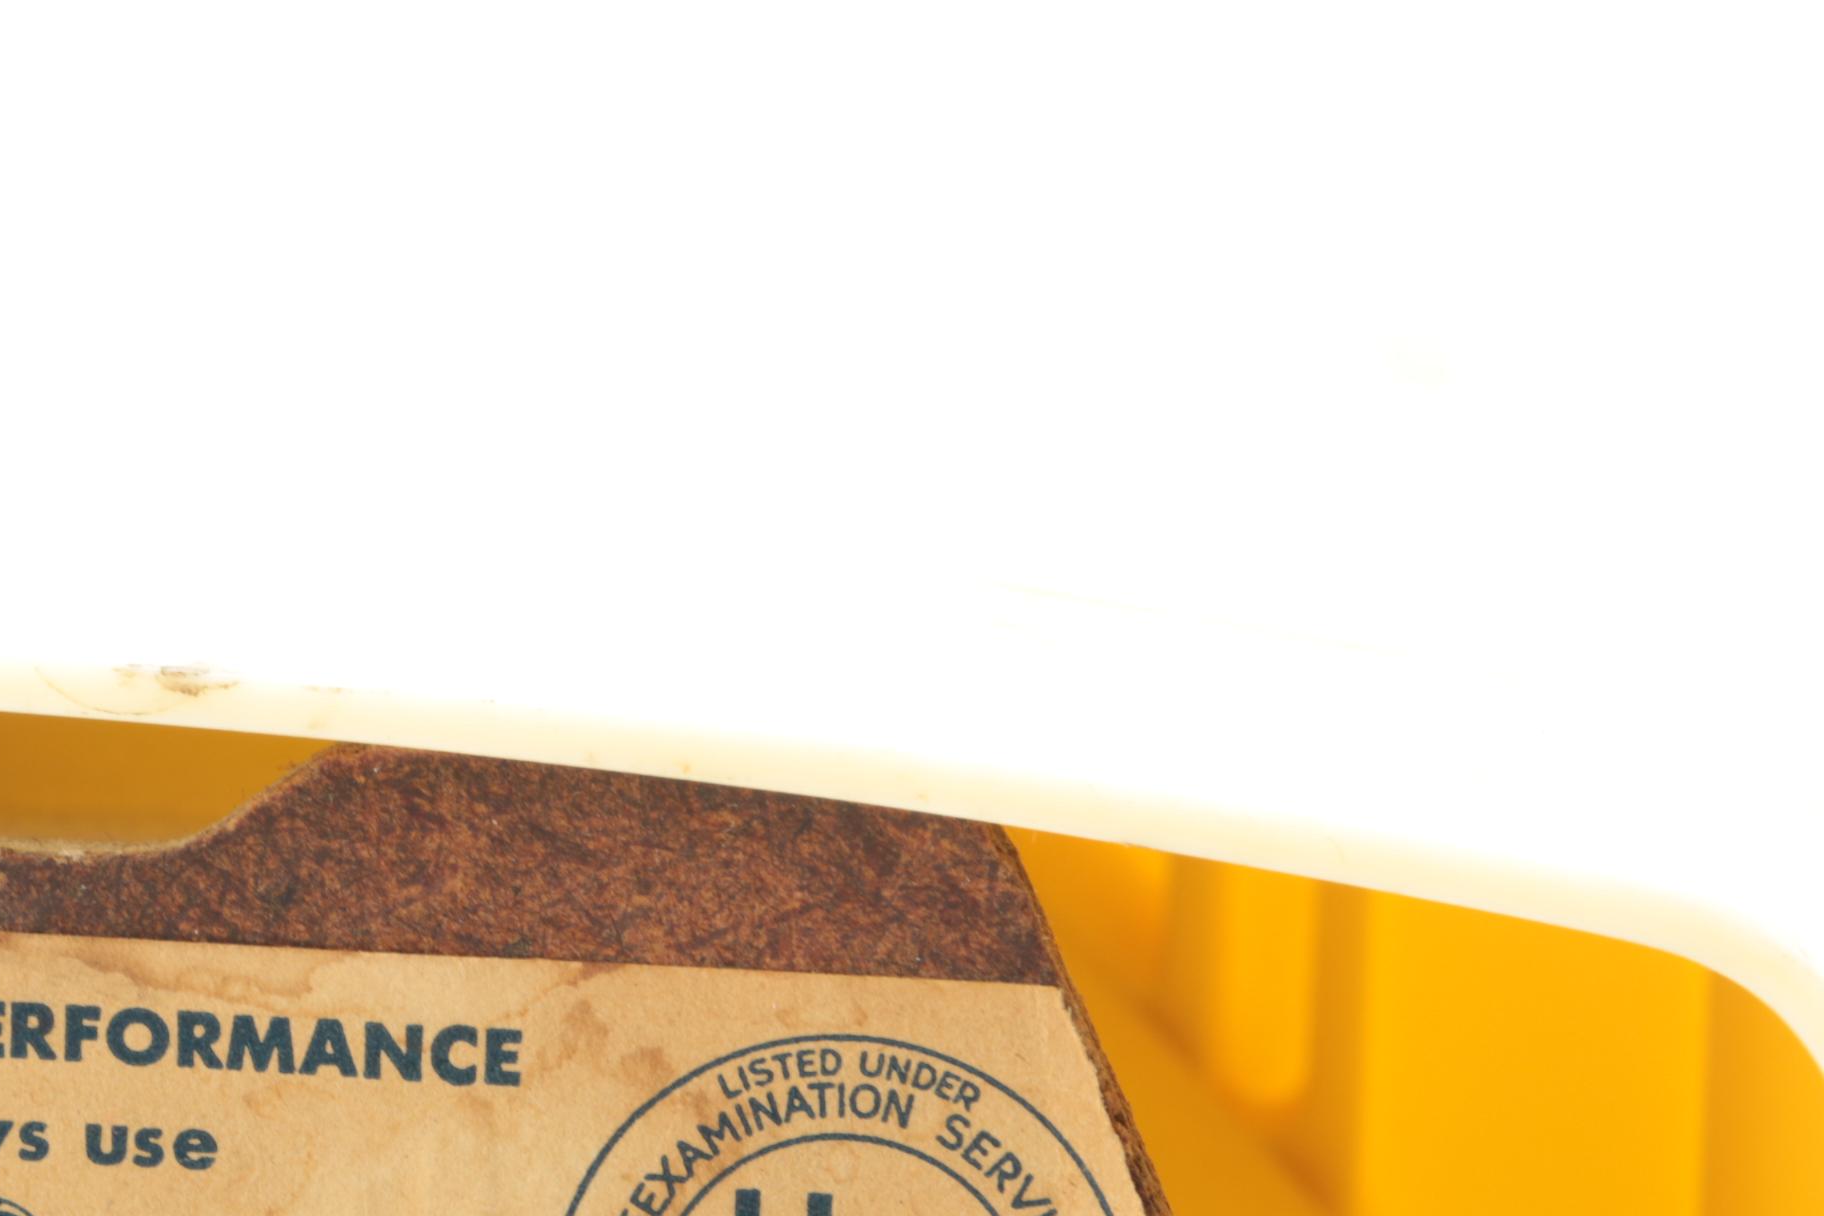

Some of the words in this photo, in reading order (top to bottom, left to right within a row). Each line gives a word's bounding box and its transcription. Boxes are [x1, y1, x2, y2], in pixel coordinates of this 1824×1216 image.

[716, 1048, 843, 1100] LISTED
[858, 1050, 982, 1113] UNDER
[85, 1123, 218, 1171] use
